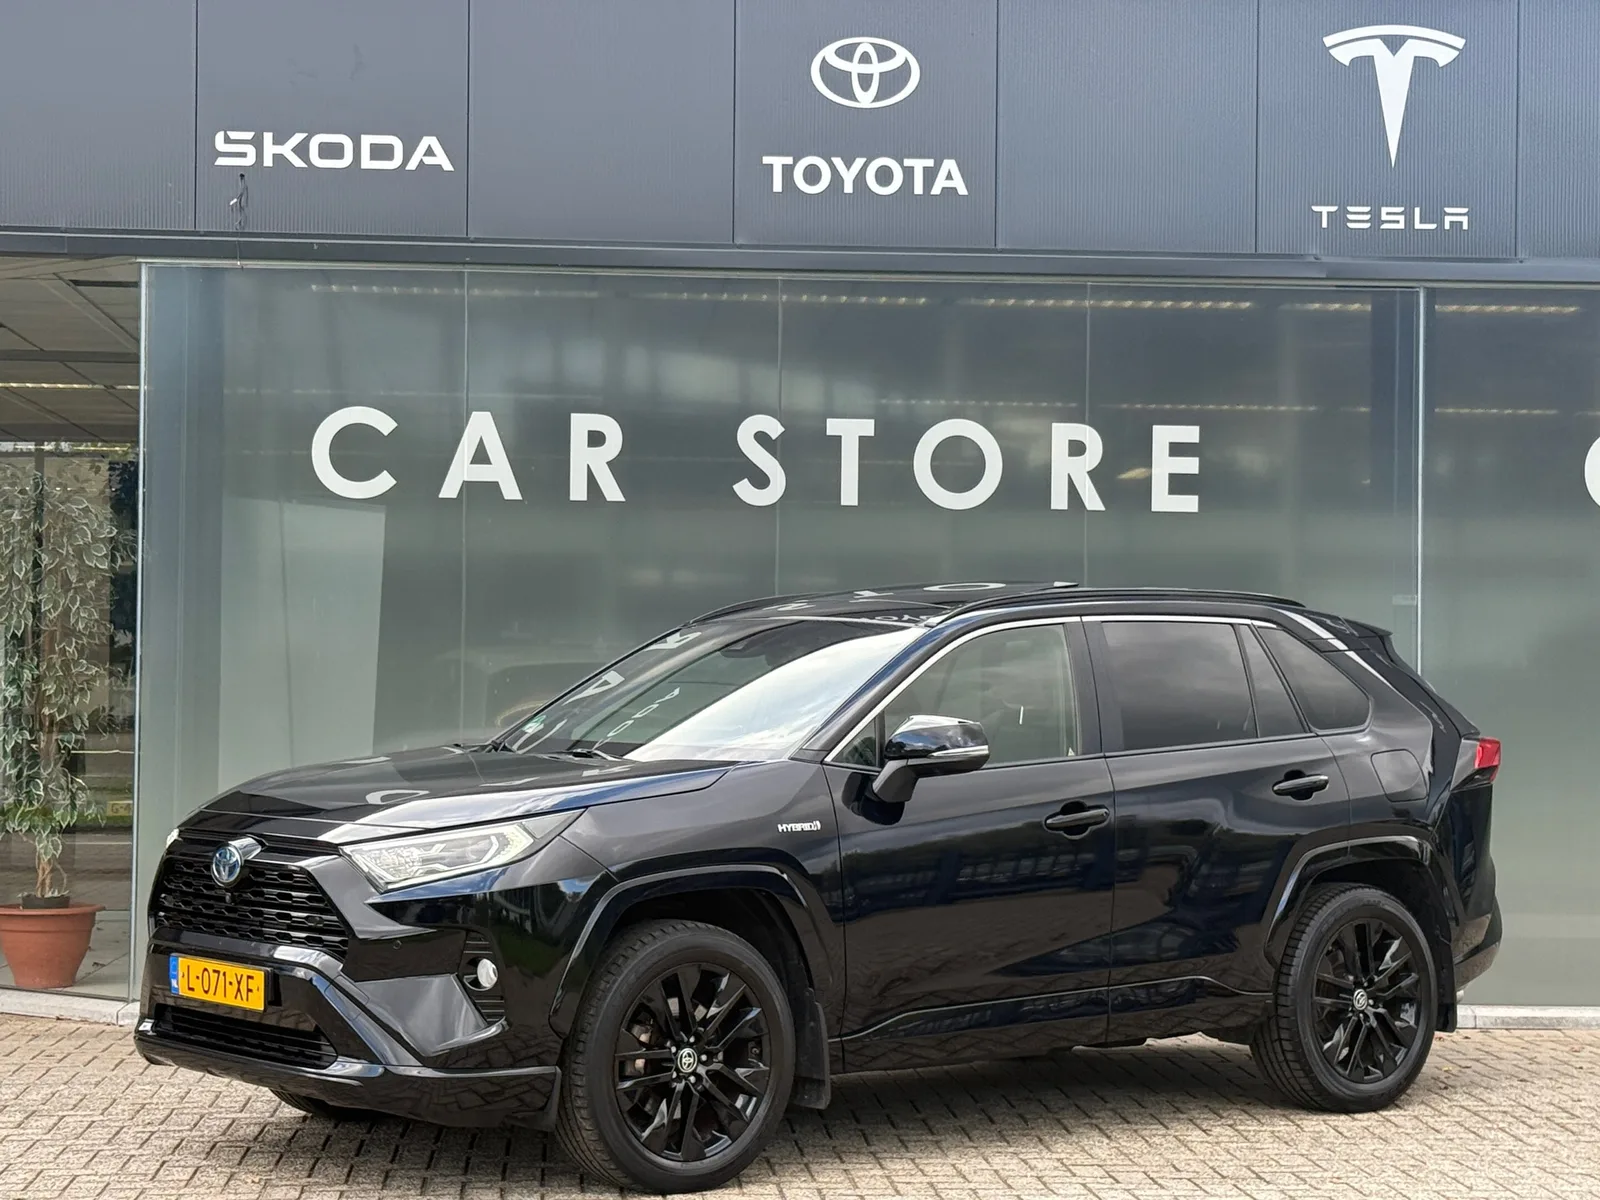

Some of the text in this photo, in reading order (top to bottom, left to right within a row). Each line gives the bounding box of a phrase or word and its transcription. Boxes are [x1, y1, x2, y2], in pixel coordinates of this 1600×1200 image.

[762, 155, 969, 197] TOYOTA
[1311, 205, 1469, 230] TESLA
[311, 405, 1200, 513] CAR STORE
[777, 822, 815, 832] HYBRID
[186, 964, 255, 1002] L-071-XF
